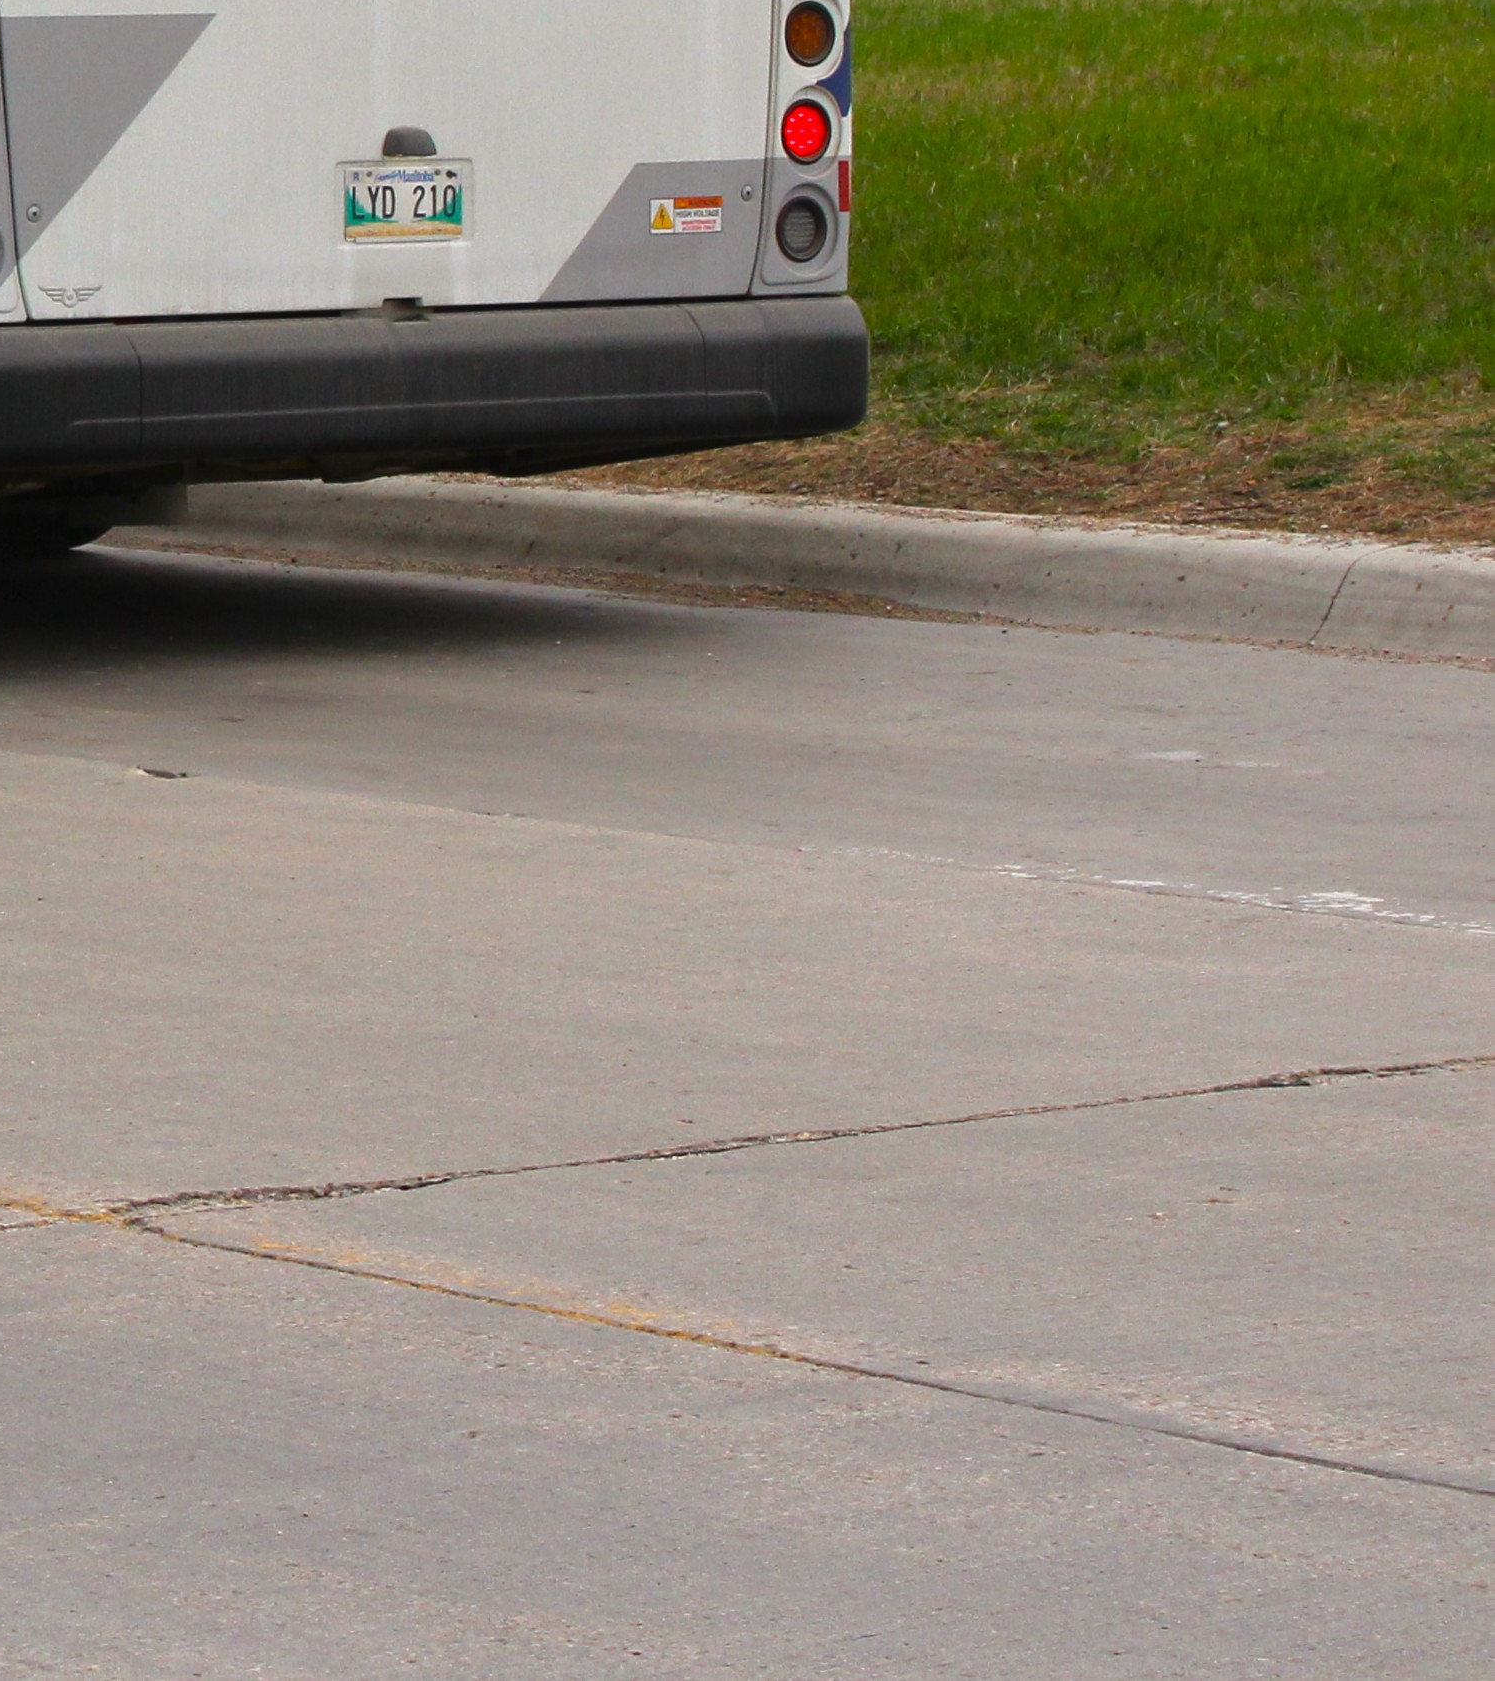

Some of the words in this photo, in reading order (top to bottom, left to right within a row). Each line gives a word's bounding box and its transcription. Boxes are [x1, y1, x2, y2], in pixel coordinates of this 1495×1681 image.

[397, 169, 434, 182] Manitoba
[352, 185, 395, 219] LYD
[413, 184, 456, 218] 210
[694, 209, 719, 217] VOLTAGE
